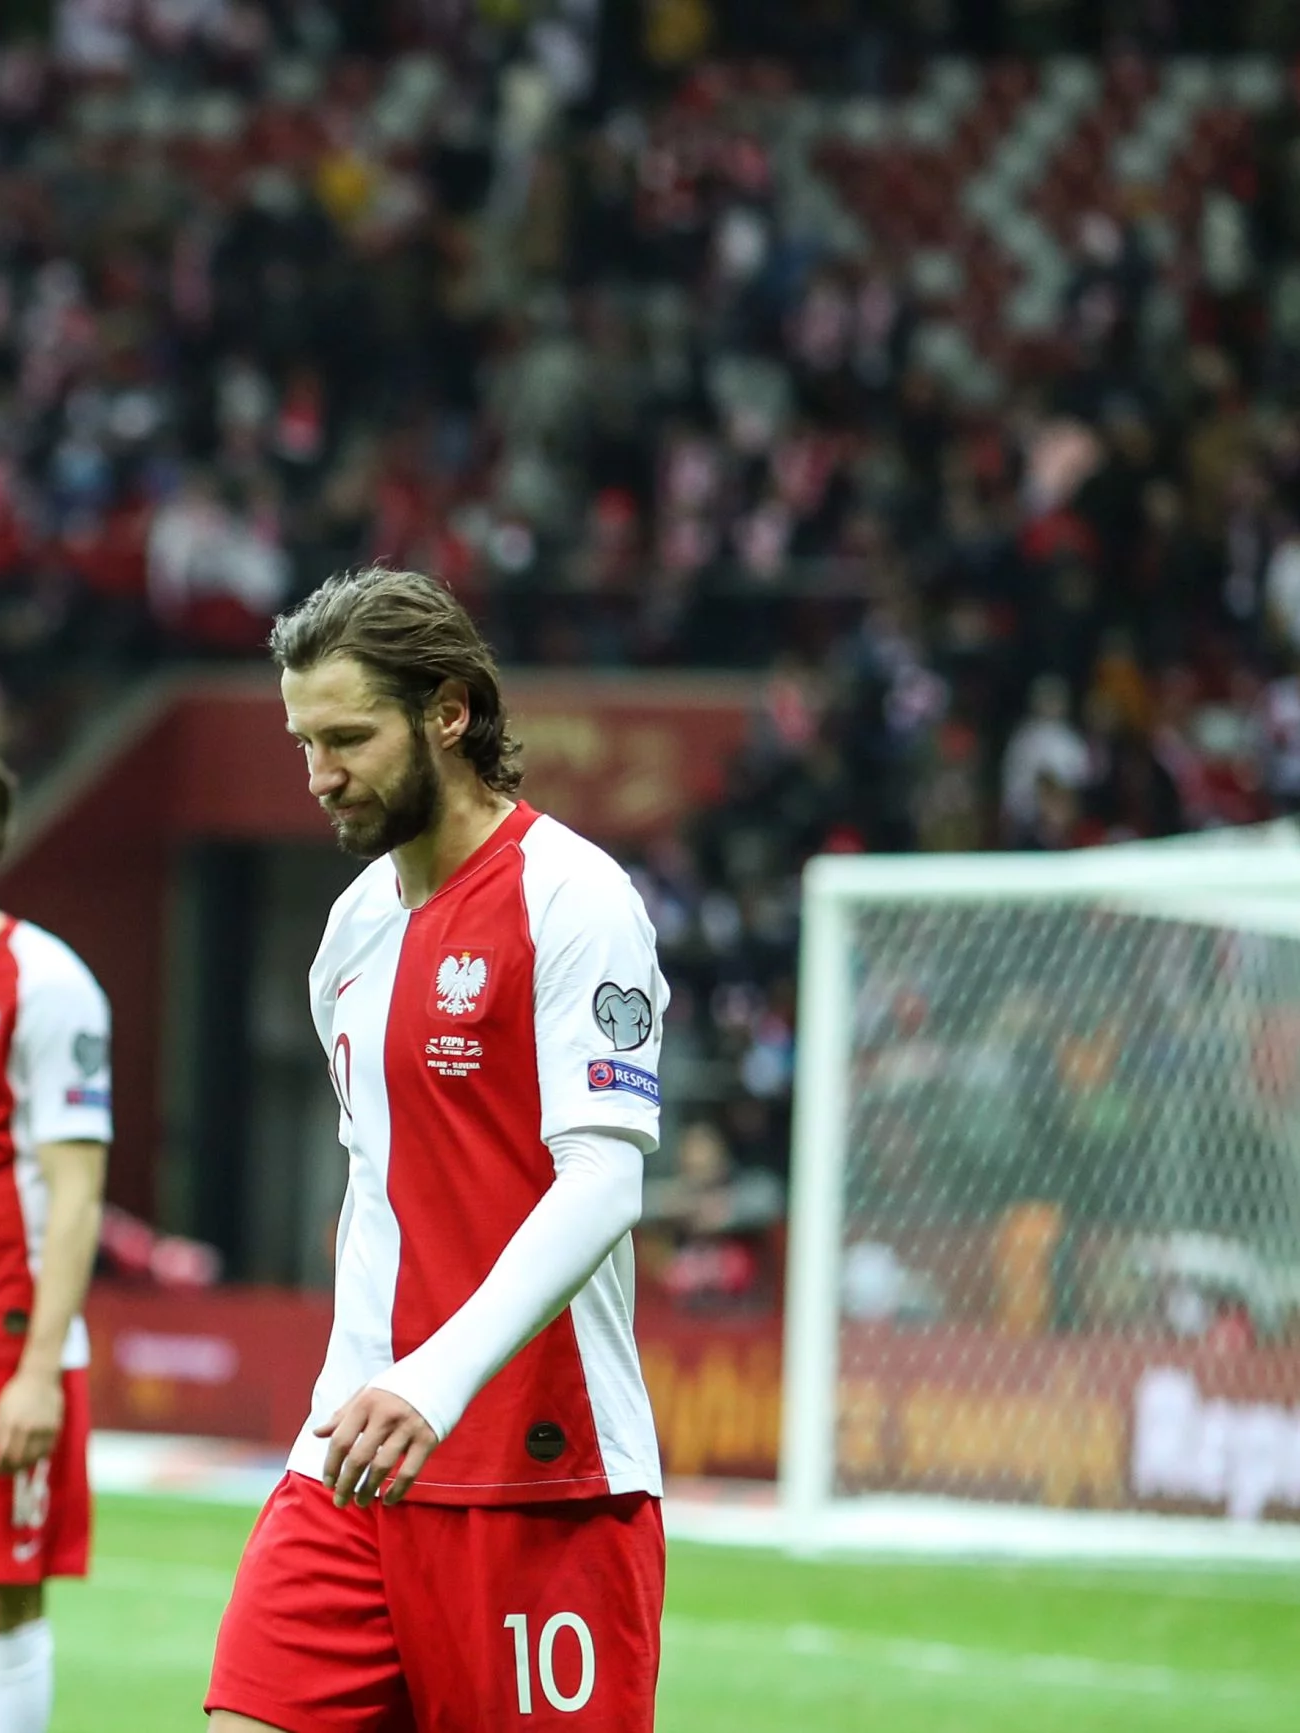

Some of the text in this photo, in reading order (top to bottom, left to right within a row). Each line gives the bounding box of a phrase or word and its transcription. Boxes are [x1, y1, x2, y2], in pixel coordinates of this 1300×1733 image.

[440, 1036, 465, 1048] PZPN
[614, 1068, 659, 1097] RESPECT
[503, 1611, 596, 1714] 10
